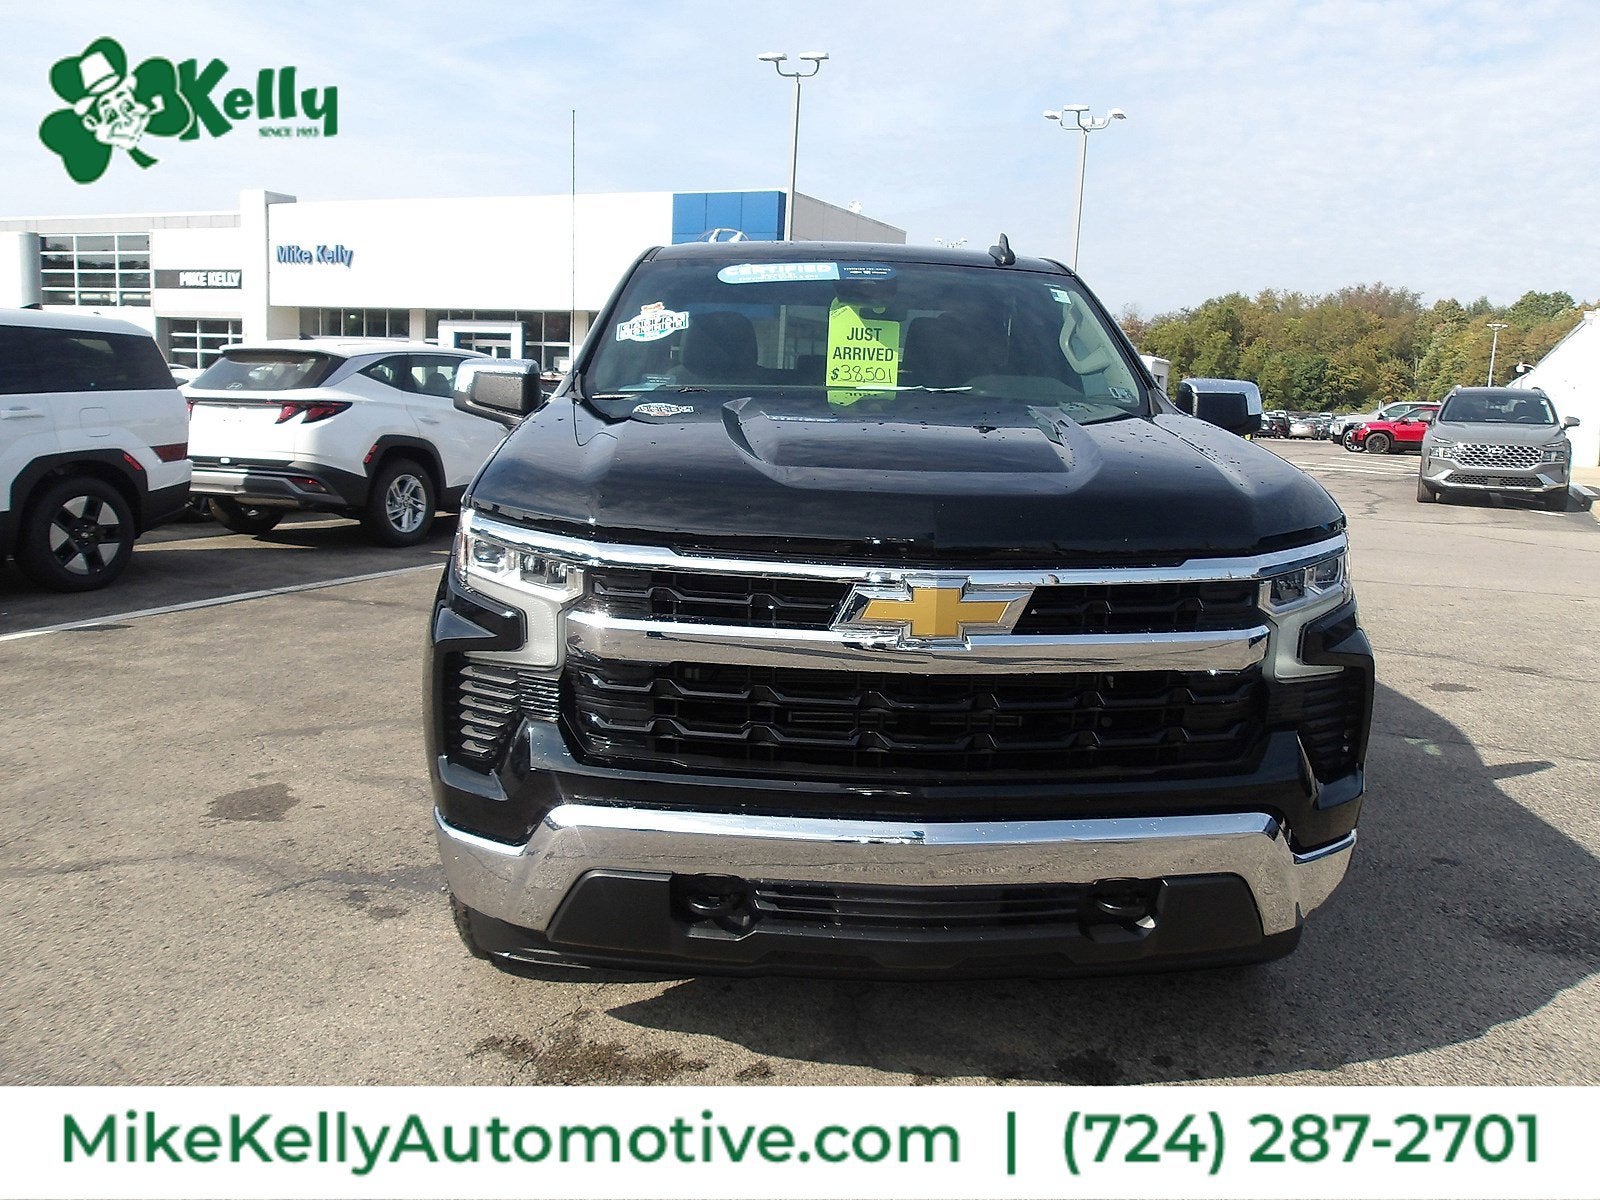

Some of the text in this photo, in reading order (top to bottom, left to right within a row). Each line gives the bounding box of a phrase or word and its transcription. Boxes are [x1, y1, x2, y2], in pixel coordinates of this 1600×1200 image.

[277, 245, 354, 268] Mike Kelly
[179, 271, 240, 286] MIKE KELLY
[846, 327, 882, 341] JUST
[832, 346, 894, 361] ARRIVED
